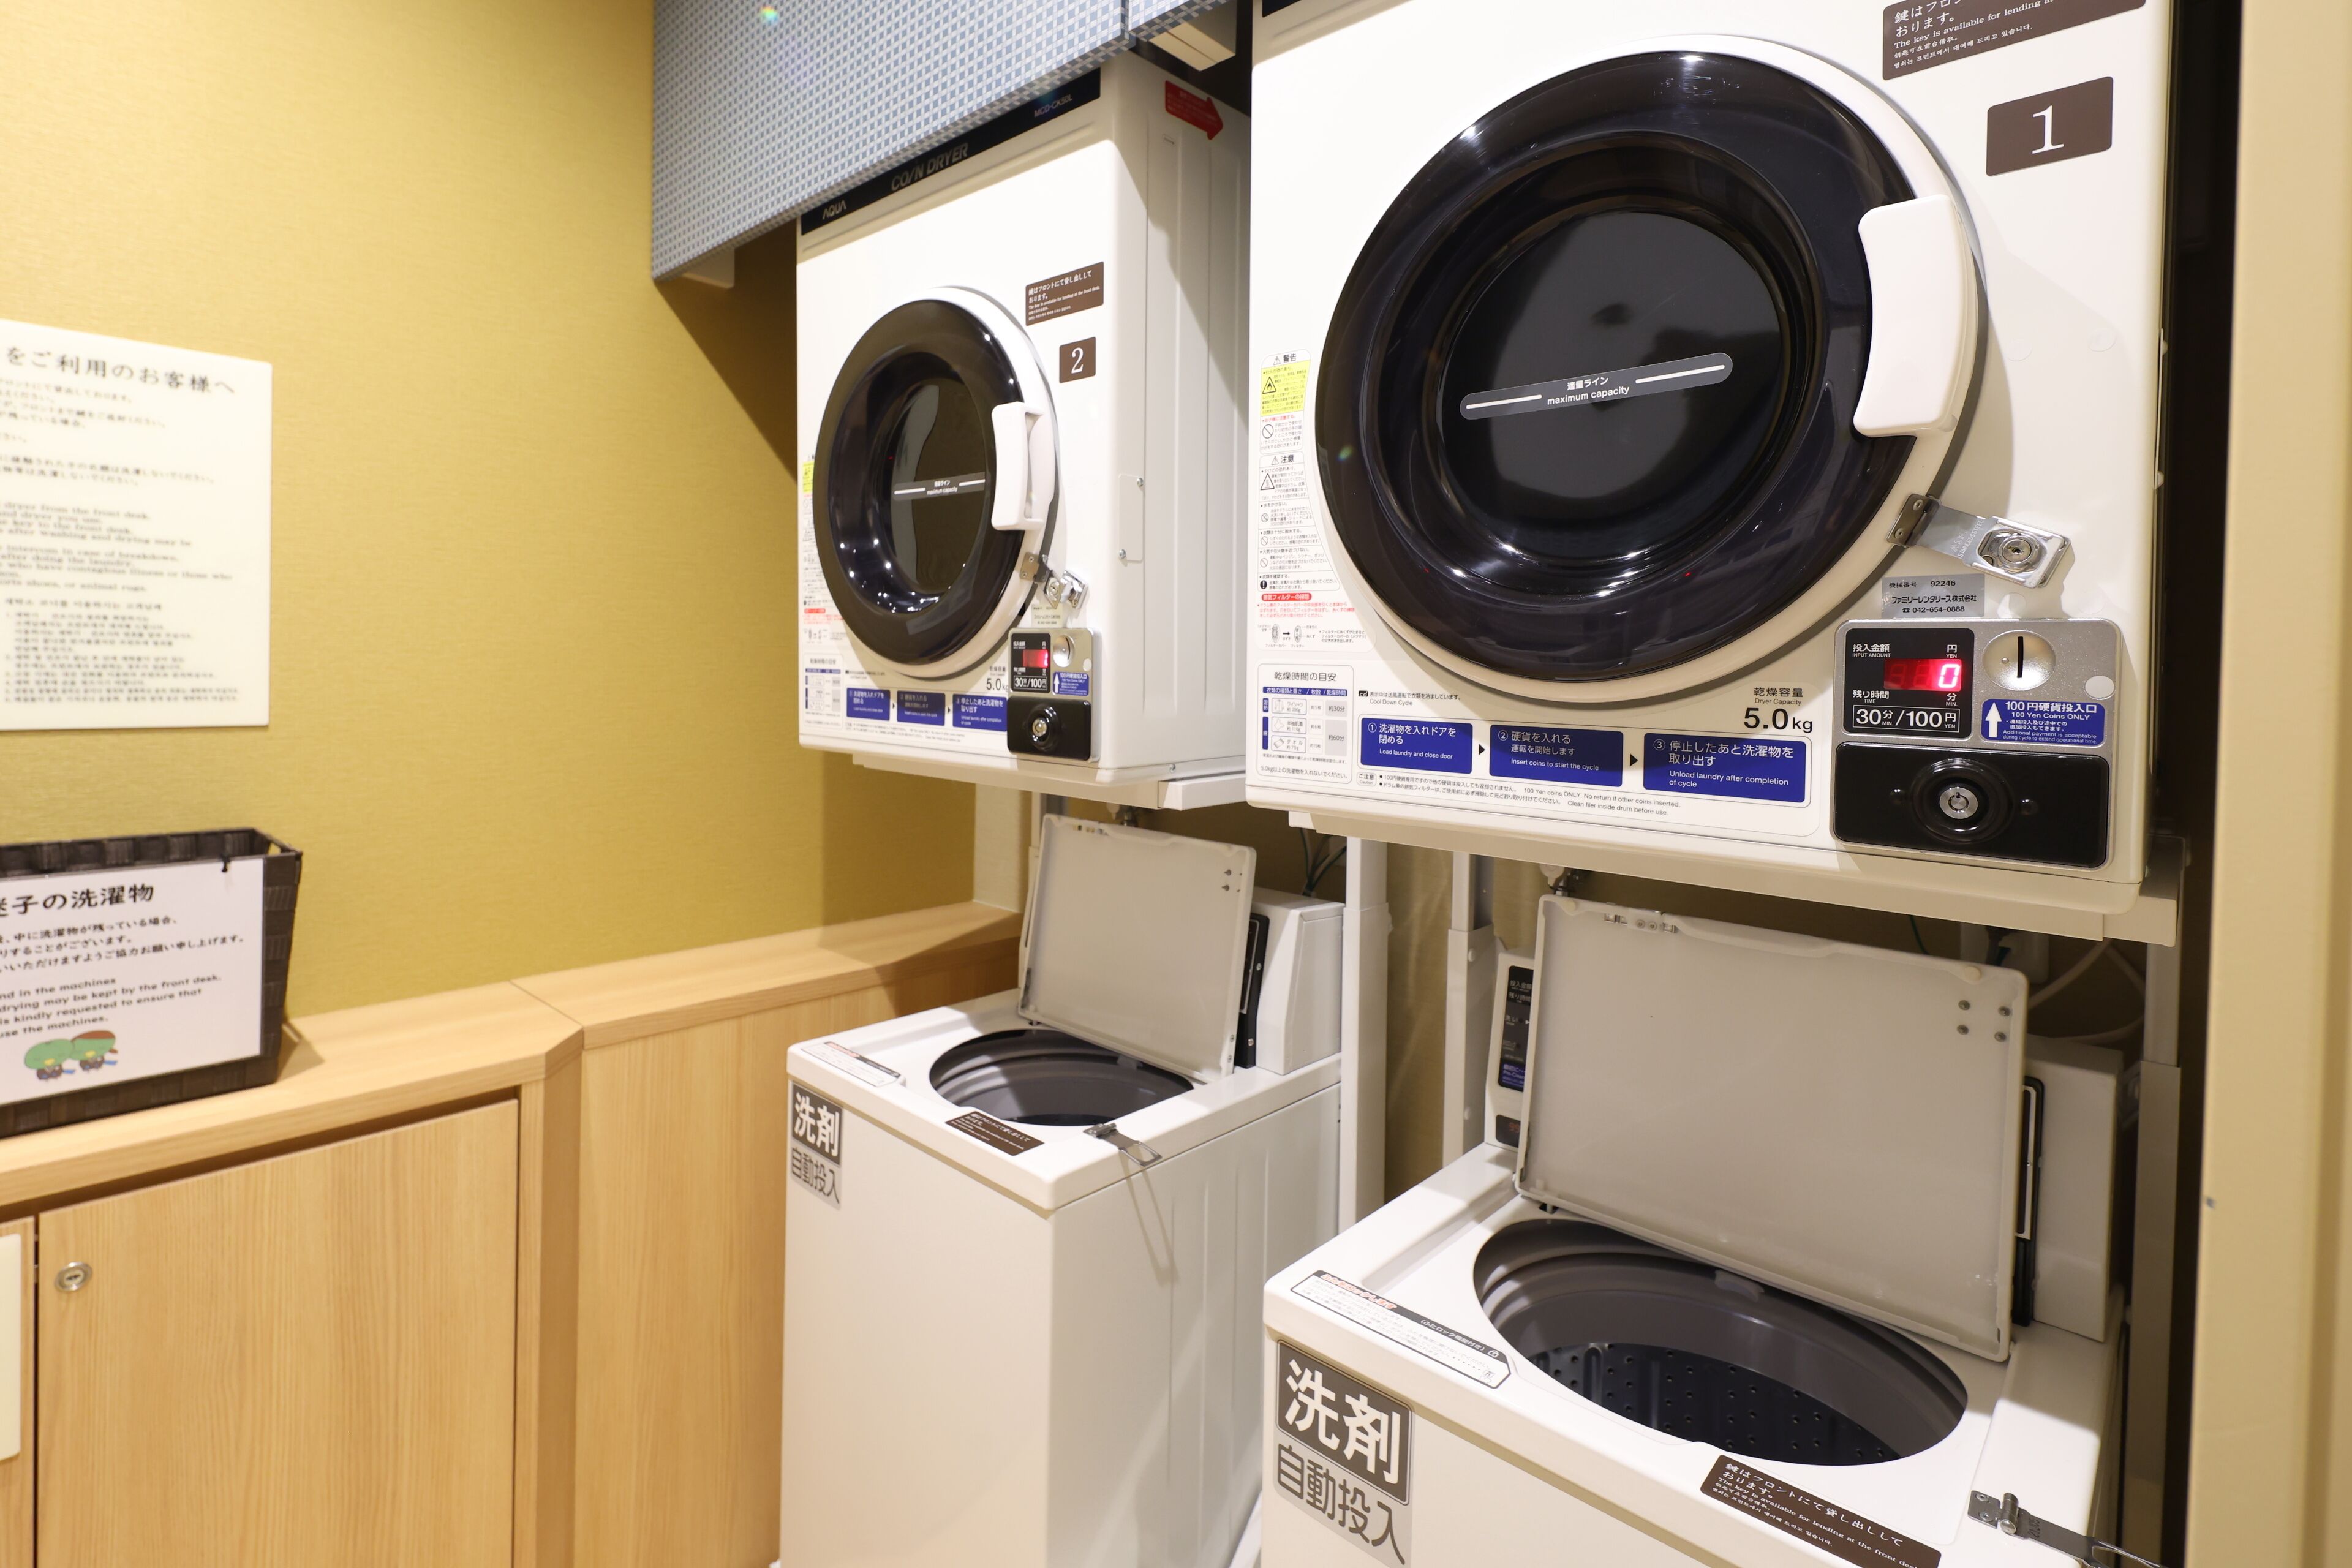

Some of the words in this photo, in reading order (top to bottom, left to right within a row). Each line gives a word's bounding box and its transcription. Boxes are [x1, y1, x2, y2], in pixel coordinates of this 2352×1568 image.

[1894, 40, 1911, 49] The
[1913, 33, 1930, 43] key
[1943, 17, 1985, 34] available
[1988, 12, 2001, 21] for
[2004, 0, 2041, 16] lending
[1896, 12, 1954, 37] おります。
[1893, 58, 1913, 69] 열쇠는
[1916, 47, 1950, 62] 프런트에서
[1953, 39, 1973, 51] 대여해
[1977, 33, 1998, 44] 드리고
[2001, 23, 2033, 37] 있습니다.
[2032, 105, 2064, 154] 1
[927, 142, 969, 175] DRYER
[823, 200, 846, 221] AQUA
[1071, 347, 1084, 374] 2
[1283, 353, 1297, 363] 警告
[7, 347, 236, 393] をご利用のお客様へ
[1567, 377, 1609, 391] 適量ライン
[1547, 392, 1589, 405] maximum
[1591, 386, 1630, 399] capacity
[1281, 454, 1294, 464] 注意
[1891, 594, 1977, 605] ファミリーレンタリース株式会社
[1852, 644, 1890, 652] 投入金額
[1947, 644, 1958, 653] 円
[1274, 671, 1336, 682] 乾燥時間の目安
[1938, 663, 1961, 688] 0
[1370, 692, 1461, 701] 表示中は送風運転で衣類を冷ましています。
[1754, 687, 1804, 698] 乾燥容量
[1852, 690, 1890, 699] 残り時間
[1947, 693, 1958, 701] 分
[1379, 723, 1457, 737] 洗濯物を入れドアを
[1379, 734, 1403, 745] 閉める
[1511, 731, 1571, 744] 硬貨を入れる
[1511, 744, 1575, 756] 運転を開始します
[1669, 740, 1794, 759] 停止したあと洗濯物を
[1669, 753, 1716, 767] 取り出す
[1669, 770, 1695, 778] Unload
[1697, 771, 1724, 782] laundry
[1745, 775, 1789, 786] completion
[1678, 780, 1697, 788] cycle
[36, 986, 55, 995] the
[59, 978, 116, 991] machines
[44, 997, 69, 1006] may
[91, 989, 118, 998] kept
[122, 987, 135, 995] by
[161, 978, 190, 989] front
[193, 974, 221, 984] desk.
[14, 1011, 53, 1022] kindly
[56, 1001, 118, 1016] requested
[136, 993, 175, 1005] ensure
[179, 988, 202, 997] that
[23, 1025, 43, 1034] the
[47, 1016, 109, 1030] machines.
[794, 1091, 840, 1157] 洗剤
[791, 1147, 840, 1204] 自動投入
[1284, 1358, 1401, 1485] 洗剤
[1722, 1471, 1773, 1498] おります。
[1278, 1443, 1406, 1566] 自動投入
[1725, 1463, 1904, 1547] 鍵はフロントにて貸し出しして
[1718, 1477, 1733, 1487] The
[1734, 1485, 1749, 1494] key
[1760, 1498, 1796, 1516] available
[1812, 1520, 1845, 1538] lending
[1858, 1541, 1872, 1551] the
[1874, 1549, 1896, 1562] front
